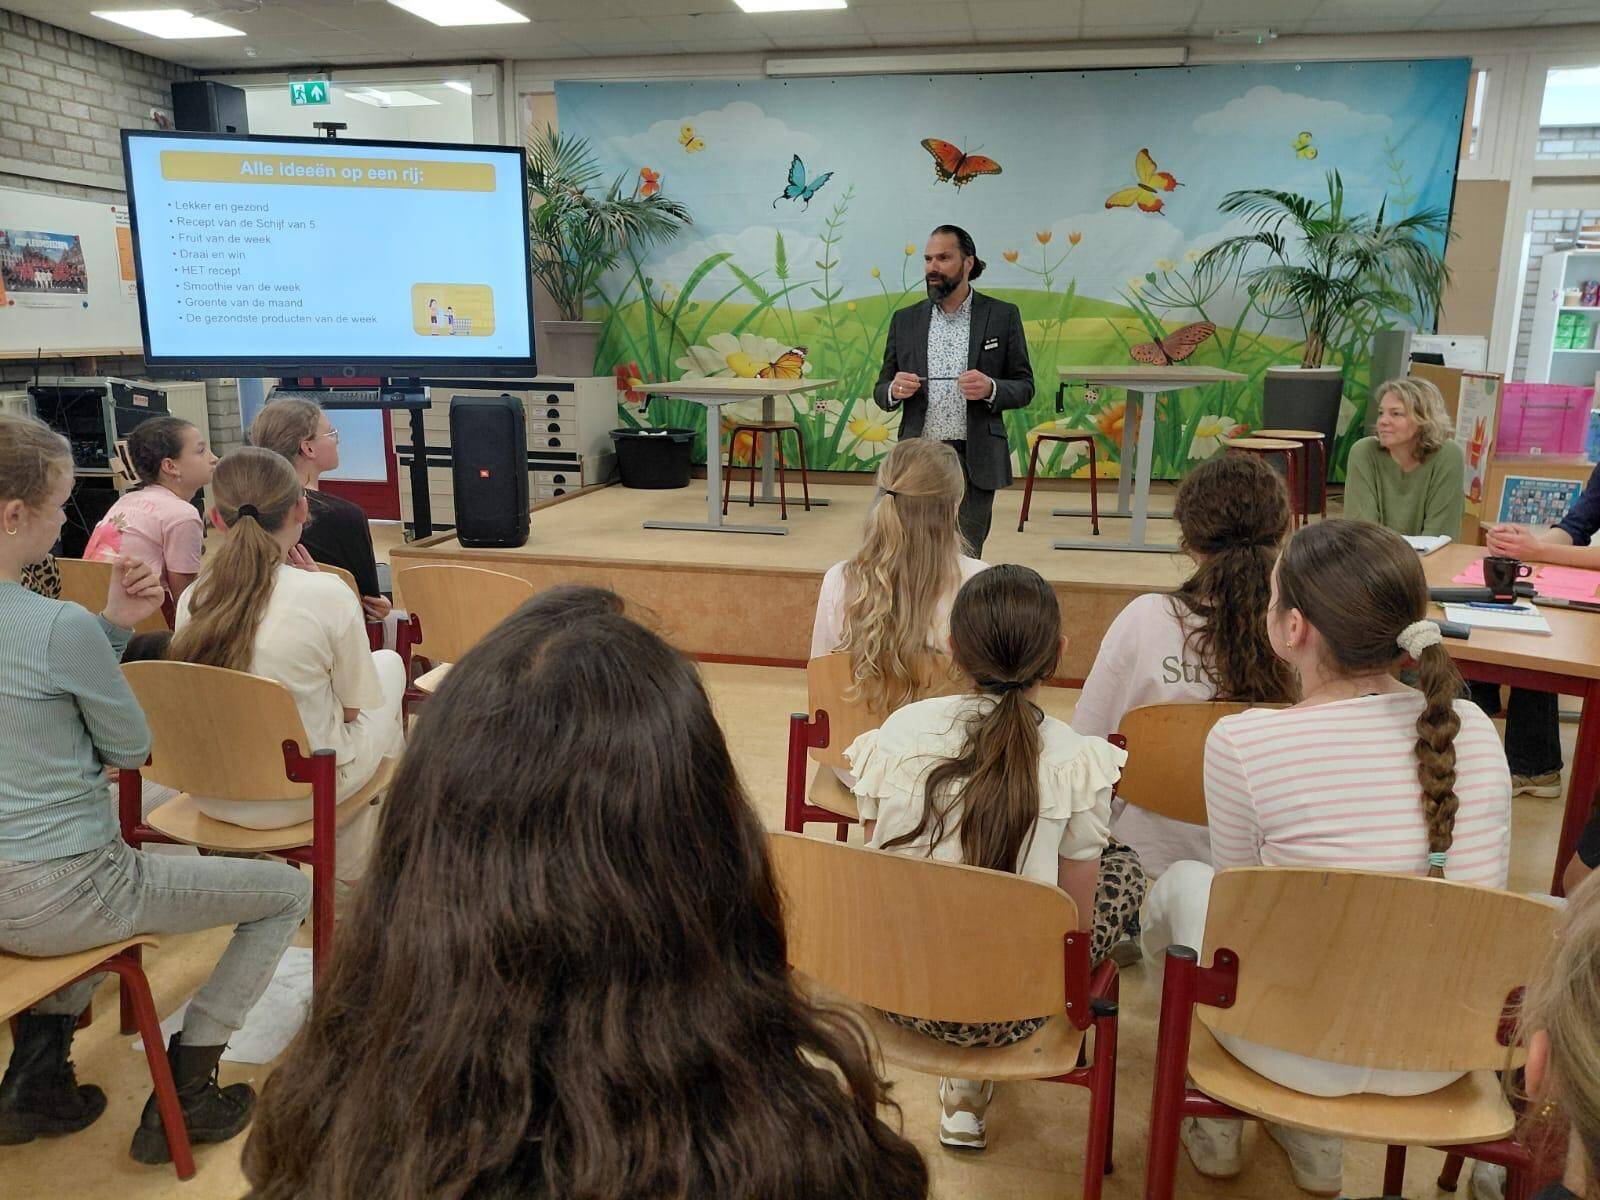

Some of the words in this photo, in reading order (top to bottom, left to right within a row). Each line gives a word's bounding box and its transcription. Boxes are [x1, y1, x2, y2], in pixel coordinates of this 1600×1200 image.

[239, 160, 273, 176] Alle
[279, 162, 336, 178] ideeën
[341, 166, 363, 182] op
[367, 167, 397, 181] een
[402, 167, 424, 184] rij:
[175, 200, 211, 210] Lekker
[214, 203, 227, 211] en
[231, 203, 269, 213] gezond
[177, 216, 215, 228] Recept
[218, 219, 236, 227] van
[240, 219, 253, 227] de
[287, 221, 306, 229] van
[309, 220, 316, 229] 5
[179, 233, 202, 243] Fruit
[205, 235, 224, 243] van
[227, 235, 240, 243] de
[244, 235, 271, 244] week
[180, 249, 208, 258] Draai
[211, 251, 224, 259] en
[228, 250, 245, 259] win
[182, 265, 205, 275] HET
[208, 266, 241, 277] recept
[183, 281, 233, 291] Smoothie
[257, 282, 271, 291] de
[274, 283, 301, 292] week
[185, 297, 227, 307] Groente
[231, 299, 249, 307] van
[252, 298, 265, 307] de
[268, 299, 303, 307] maand
[186, 313, 201, 323] De
[204, 314, 258, 325] gezondste
[261, 314, 312, 325] producten
[336, 315, 349, 323] de
[352, 315, 377, 323] week
[1162, 655, 1219, 685] Str
